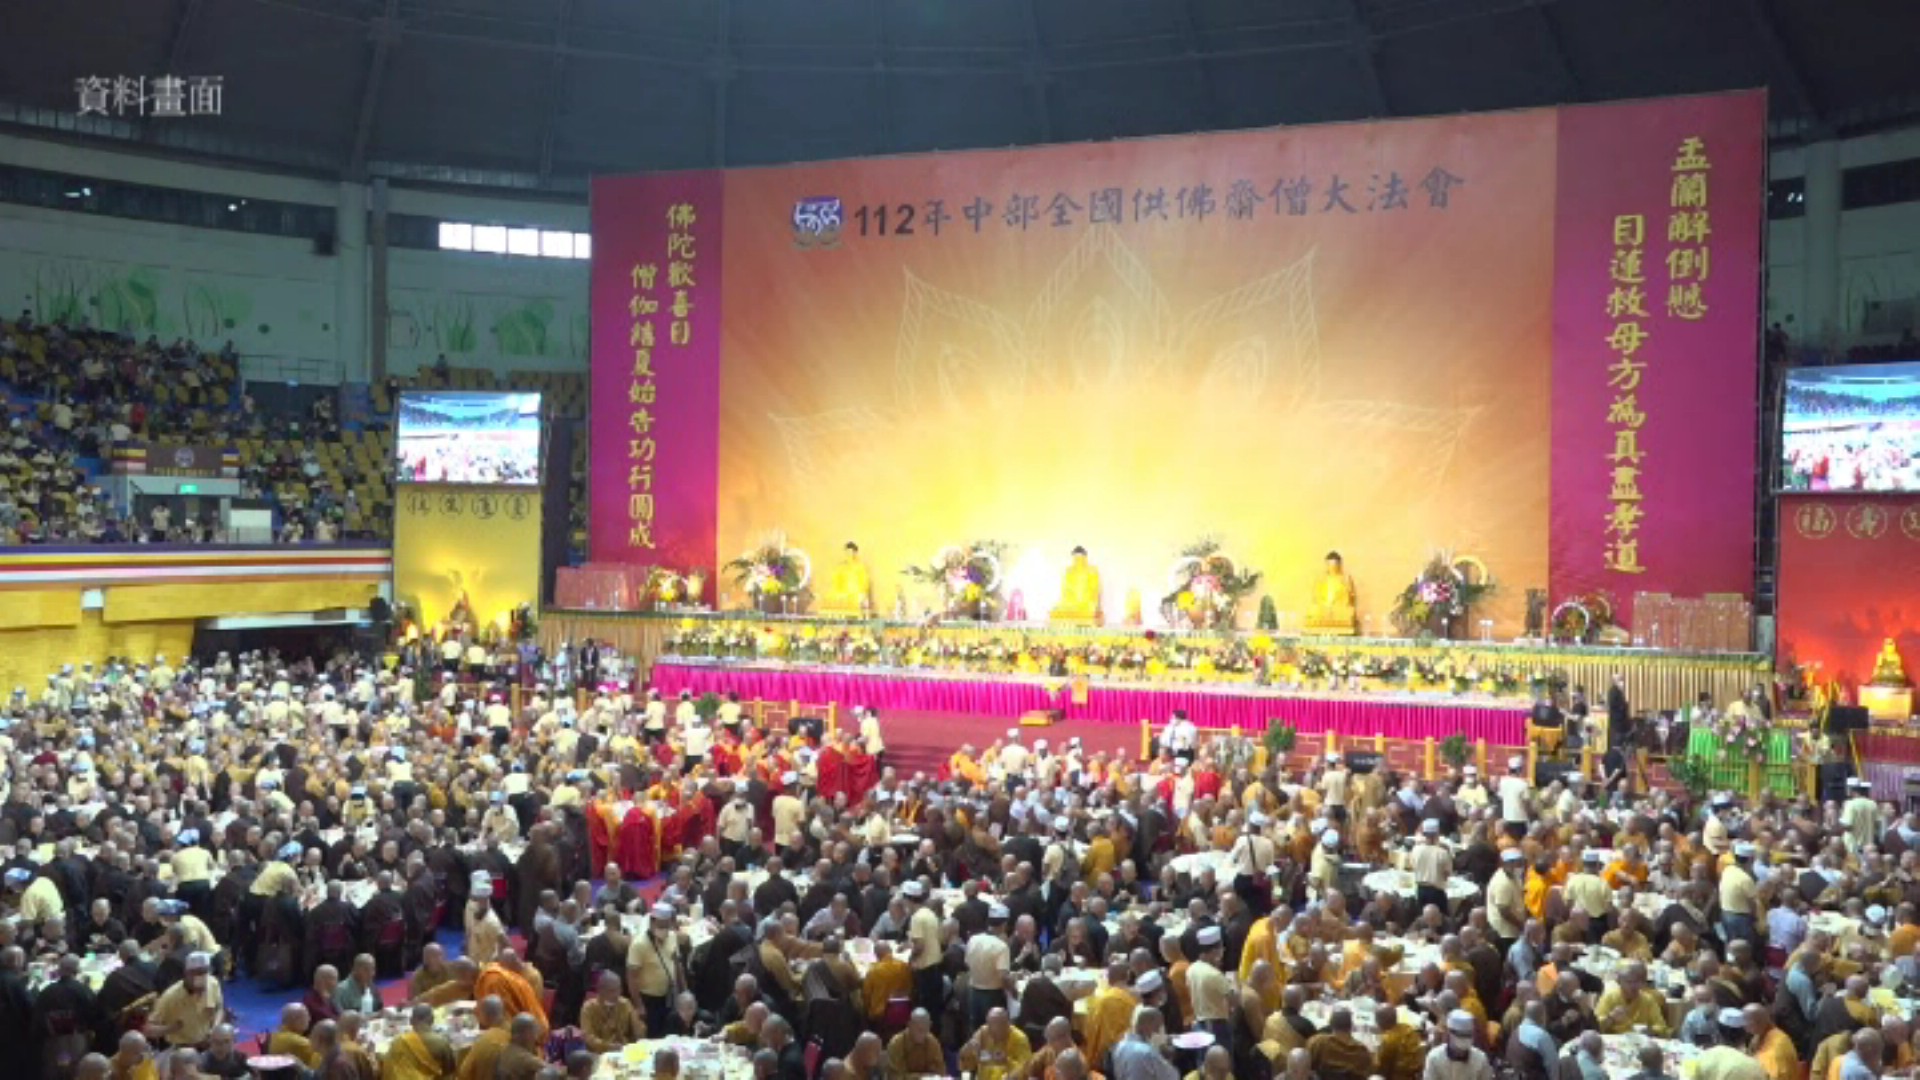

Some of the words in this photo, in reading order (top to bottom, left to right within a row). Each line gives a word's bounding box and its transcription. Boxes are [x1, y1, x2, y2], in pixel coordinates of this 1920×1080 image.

[666, 203, 696, 345] 佛陀歡喜日
